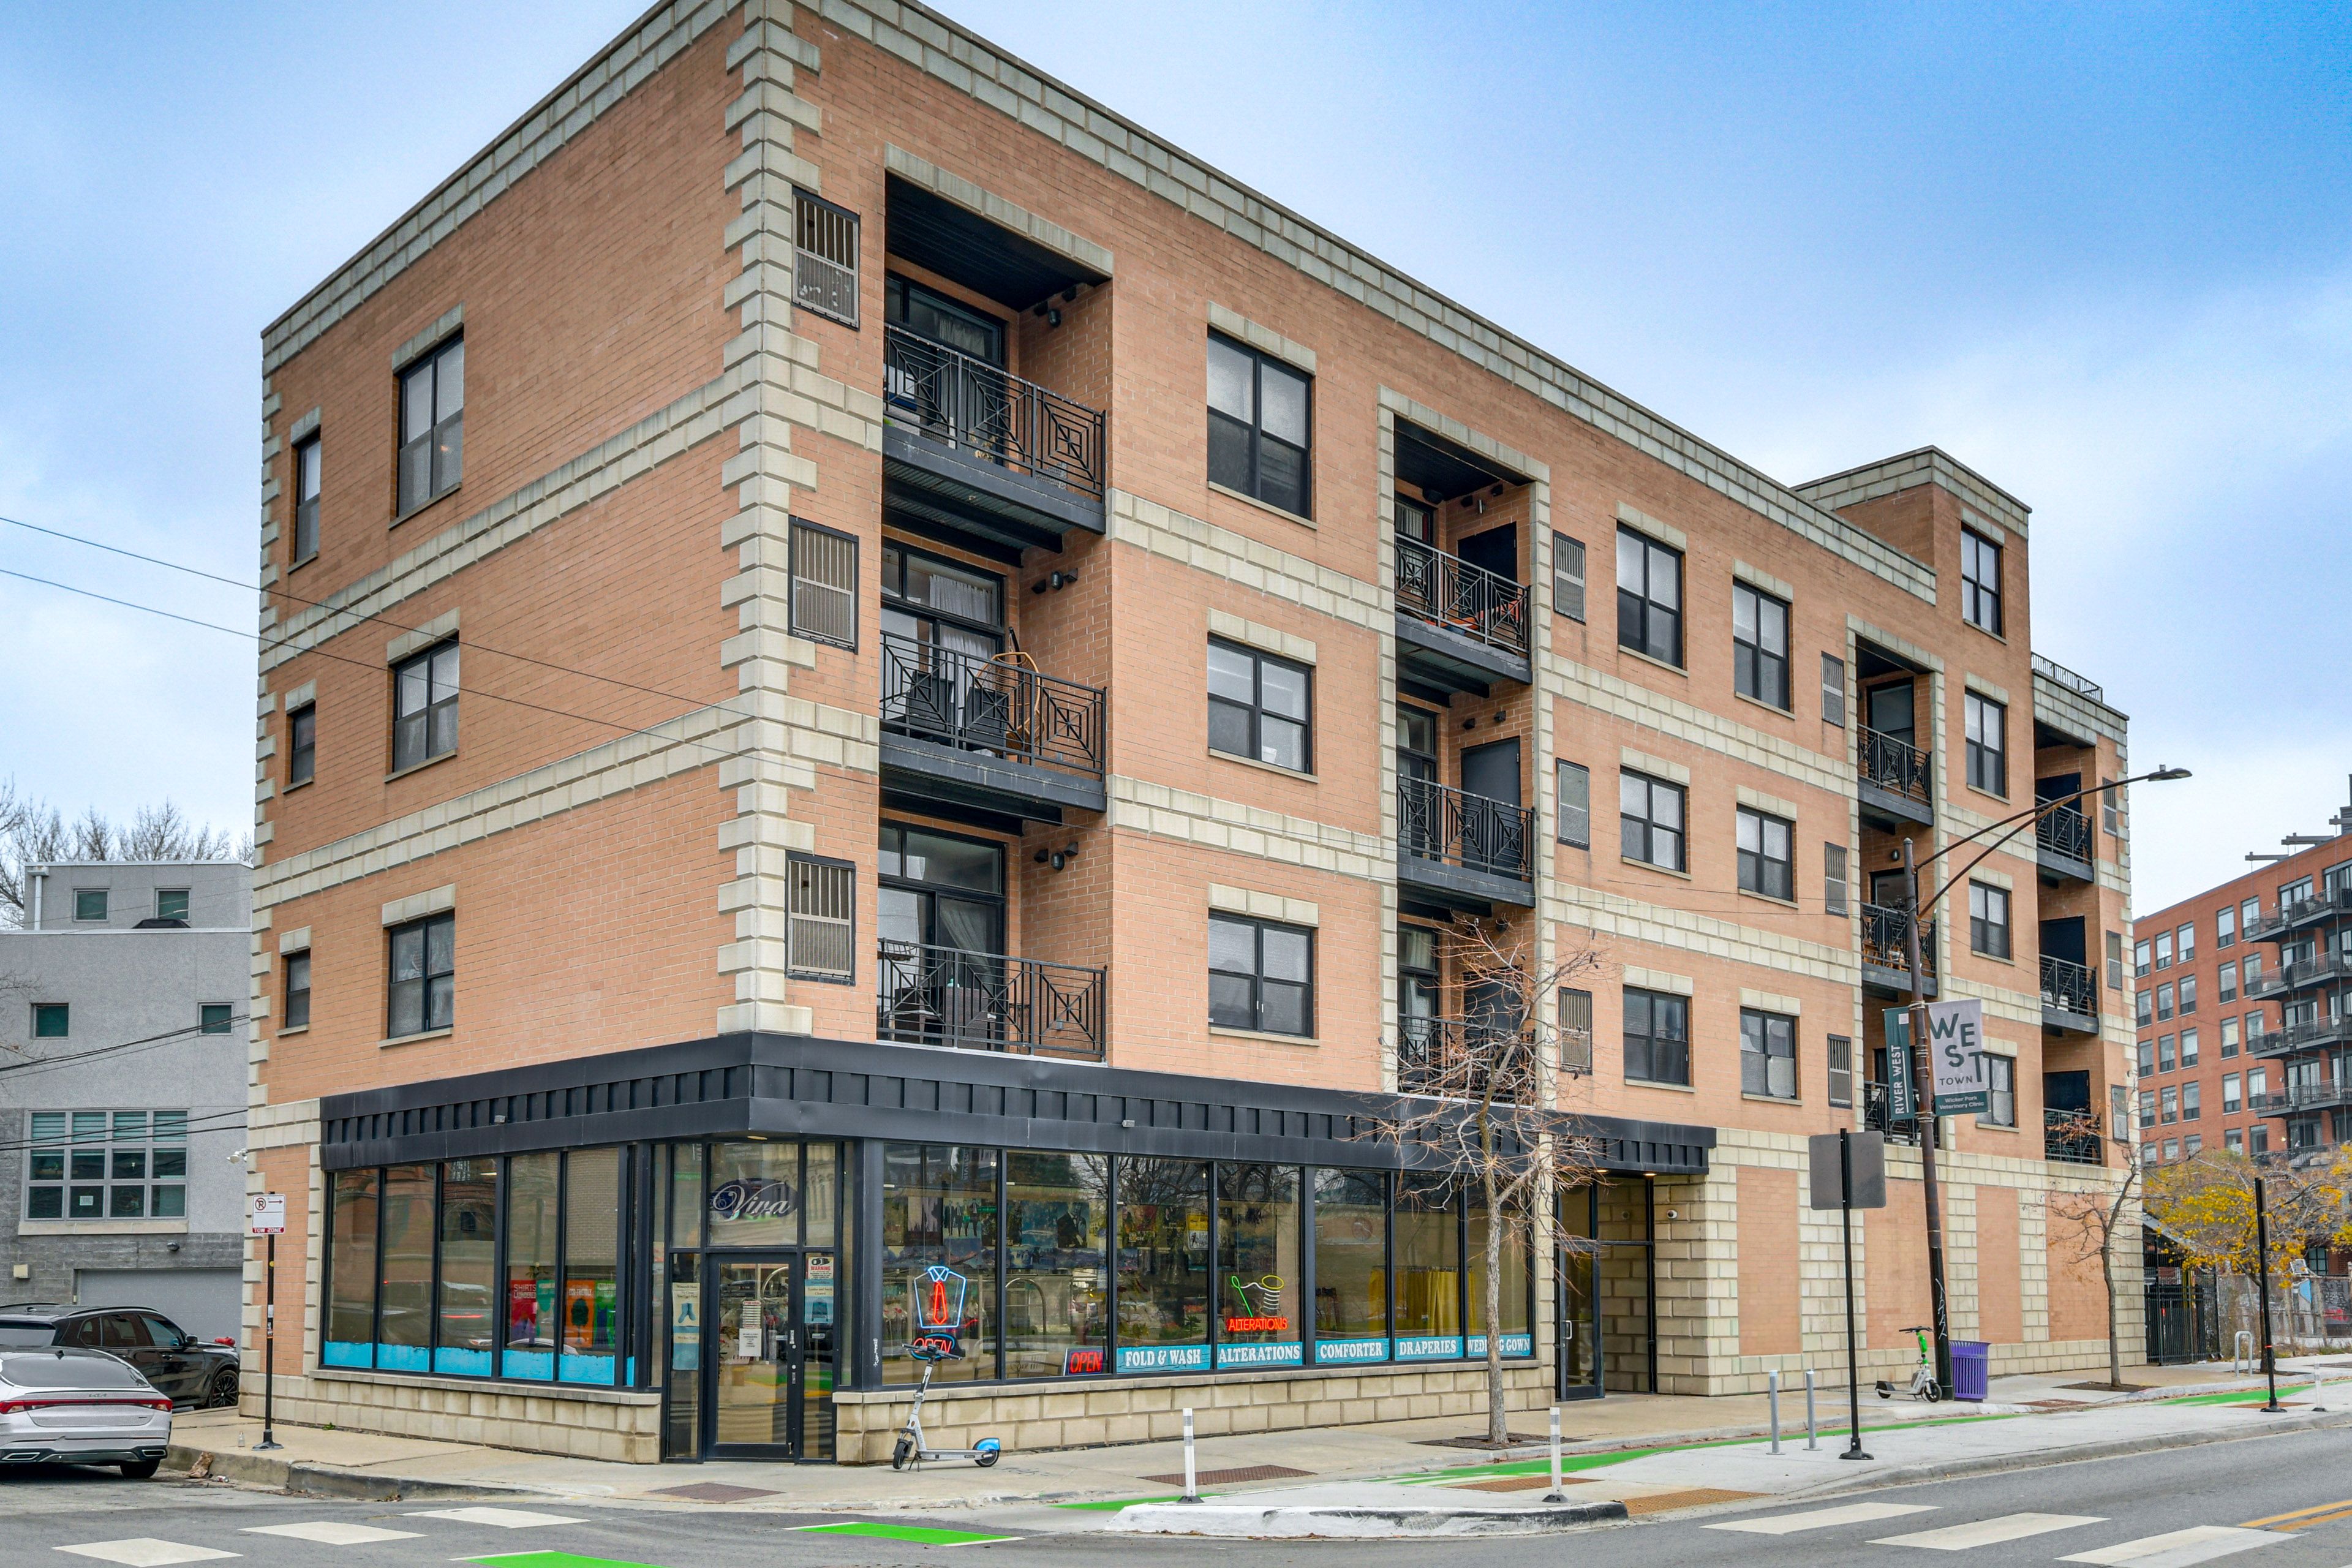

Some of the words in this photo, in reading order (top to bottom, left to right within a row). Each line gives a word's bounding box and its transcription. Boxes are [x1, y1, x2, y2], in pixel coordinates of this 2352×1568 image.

[1891, 1045, 1902, 1077] WEST
[1939, 1076, 1973, 1086] TOWN
[1893, 1082, 1905, 1114] RIVER
[713, 1182, 791, 1221] Viva
[1227, 1317, 1287, 1332] ALTERATIONS
[1320, 1343, 1382, 1359] COMFORTER
[1399, 1340, 1457, 1355] DRAPERIES
[1506, 1338, 1530, 1352] GOWN
[1069, 1351, 1102, 1373] OPEN
[1125, 1351, 1155, 1366] FOLD
[1158, 1350, 1166, 1365] &
[1169, 1349, 1200, 1365] WASH
[1218, 1345, 1300, 1363] ALTERATIONS
